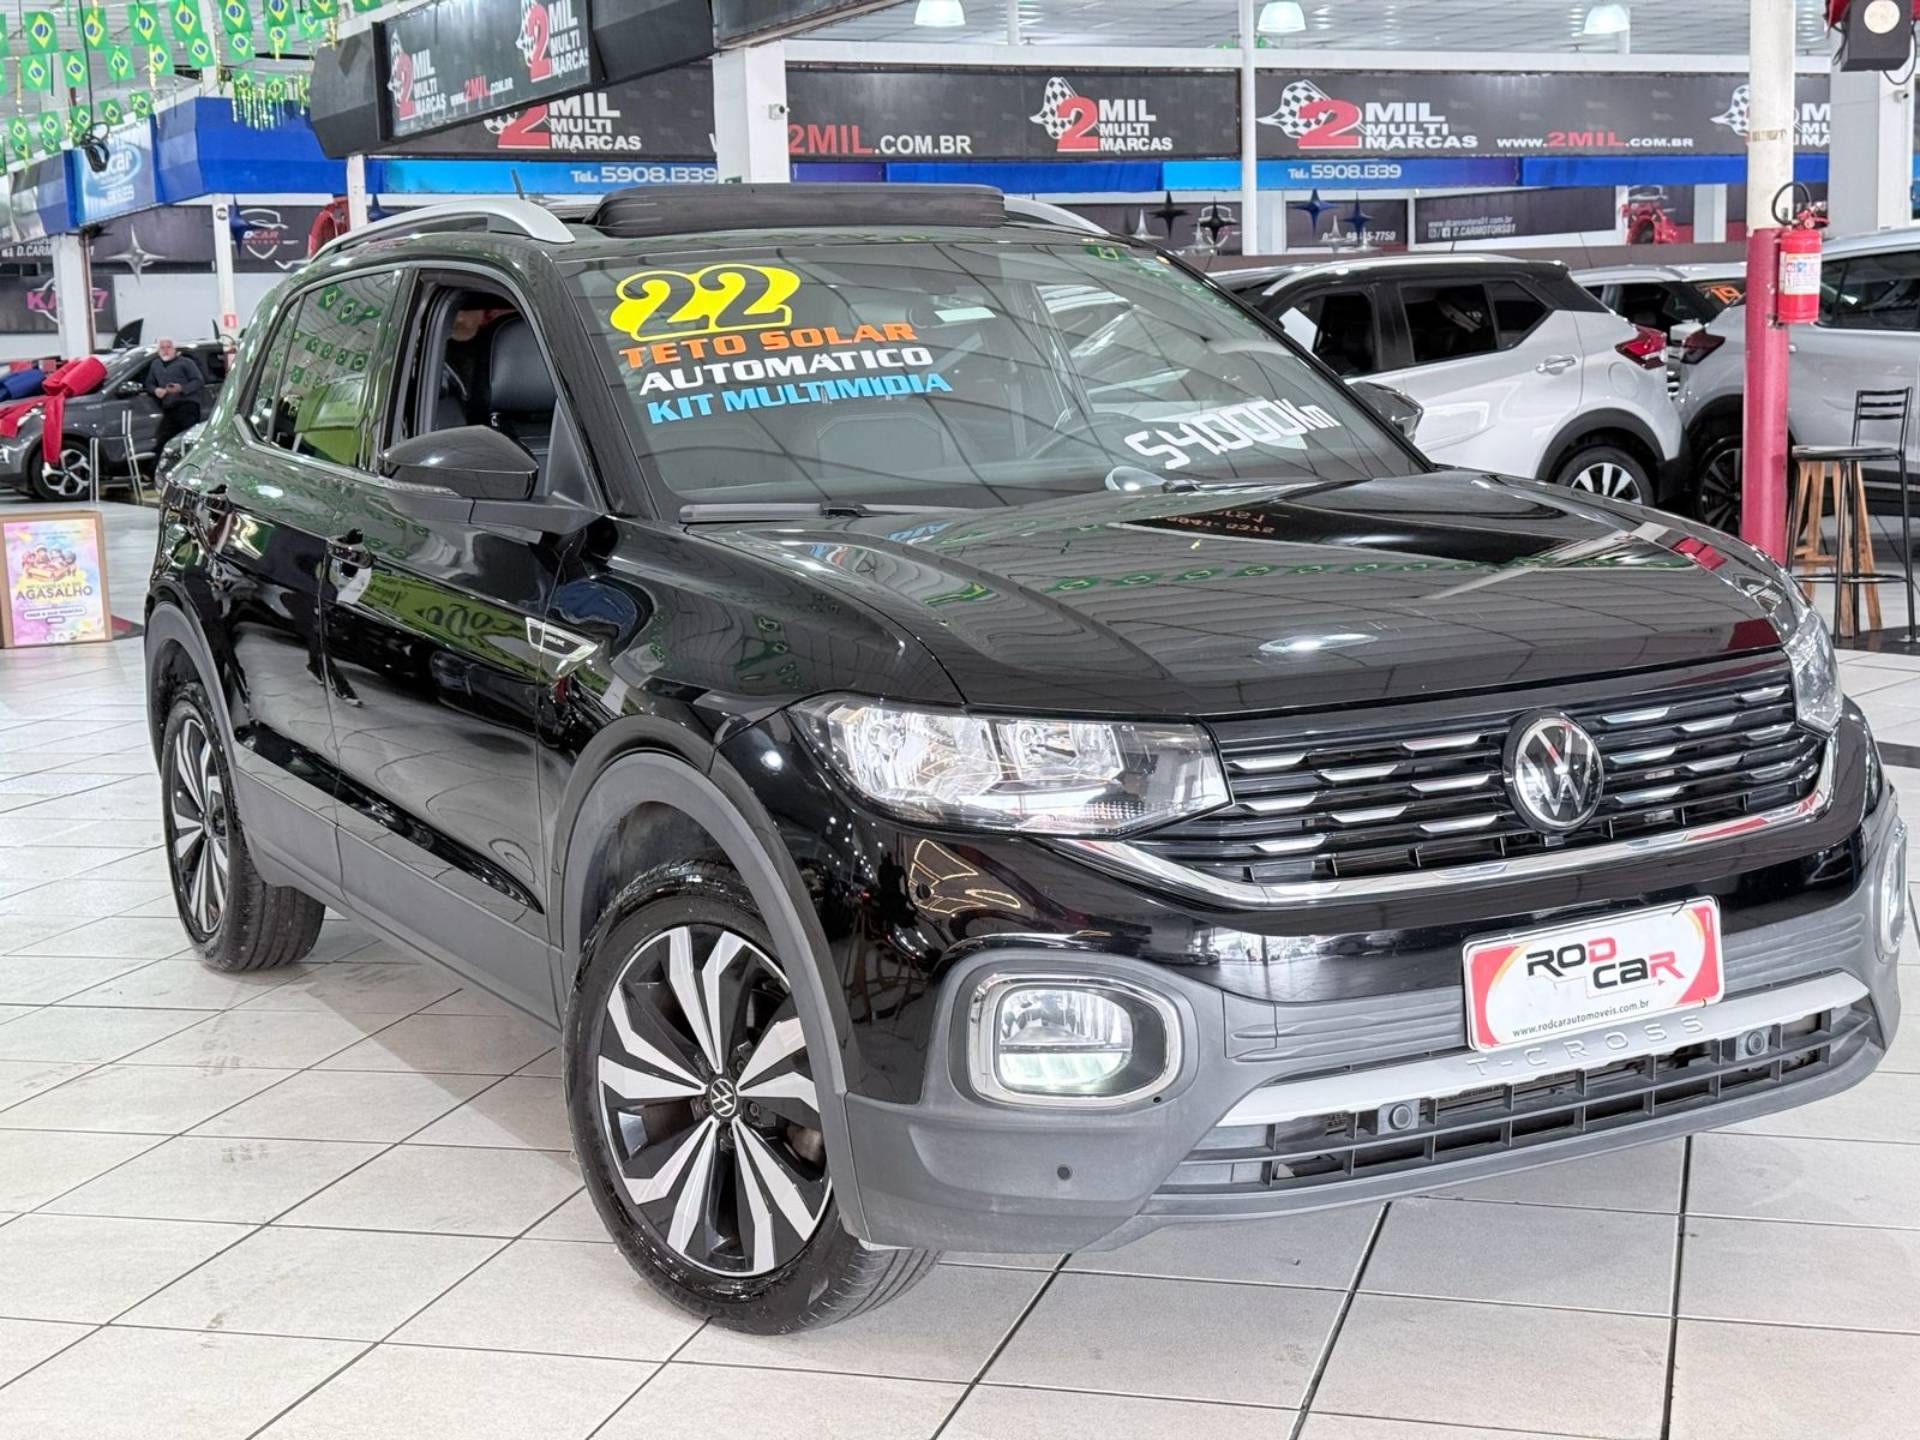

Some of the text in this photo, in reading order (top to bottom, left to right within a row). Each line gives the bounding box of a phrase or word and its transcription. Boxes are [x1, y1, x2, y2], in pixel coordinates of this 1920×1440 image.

[548, 0, 578, 34] MIL
[549, 29, 581, 56] MULTI
[412, 49, 436, 79] MIL
[413, 77, 438, 99] MULTI
[415, 93, 447, 115] MARCAS
[550, 92, 621, 117] MIL
[550, 117, 612, 134] MULTI
[1057, 96, 1157, 152] 2 MIL
[1099, 123, 1150, 136] MULTI
[1297, 99, 1446, 149] 2 MIL
[1366, 123, 1449, 136] MULTI
[551, 134, 643, 151] MARCAS
[1099, 137, 1173, 152] MARCAS
[1366, 136, 1479, 149] MARCAS
[601, 166, 718, 183] 5908.1339
[1311, 164, 1402, 180] 5908.1339
[609, 263, 801, 343] 22
[618, 321, 919, 369] TETO SOLAR
[638, 347, 935, 396] AUTOMÁTICO
[646, 392, 715, 425] KIT
[16, 585, 93, 601] AGASALHO
[1526, 936, 1617, 978] ROD
[1512, 999, 1650, 1038] www.rodcarautomoveis.com.br
[1465, 1014, 1704, 1077] T-CROSS
